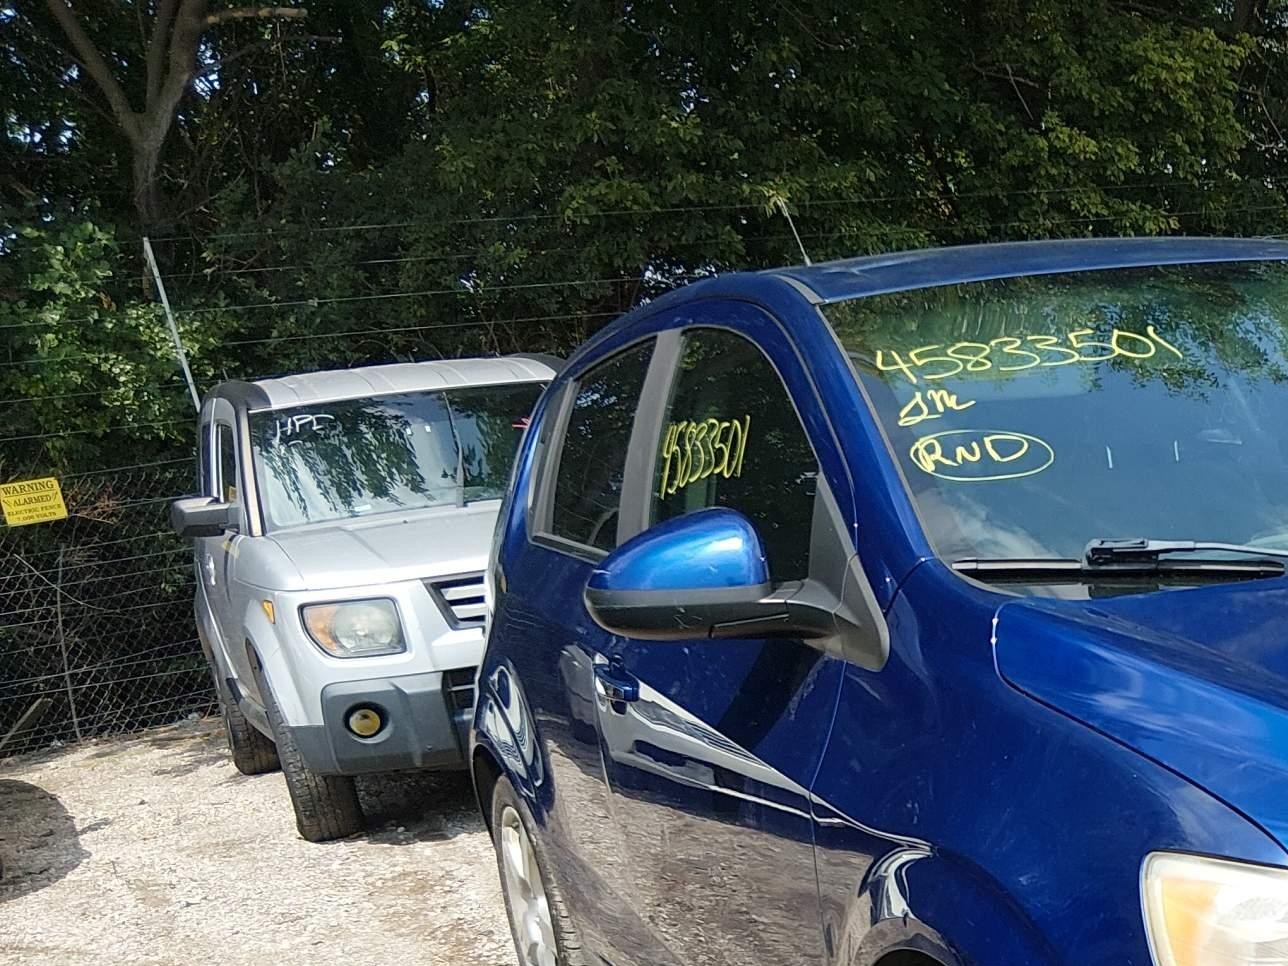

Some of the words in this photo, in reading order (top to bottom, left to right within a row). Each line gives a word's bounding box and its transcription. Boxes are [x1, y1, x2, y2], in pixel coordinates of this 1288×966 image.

[876, 325, 1182, 384] 45833501
[660, 414, 750, 500] 45833501
[2, 480, 54, 495] WARNING
[13, 495, 51, 507] ALARMED
